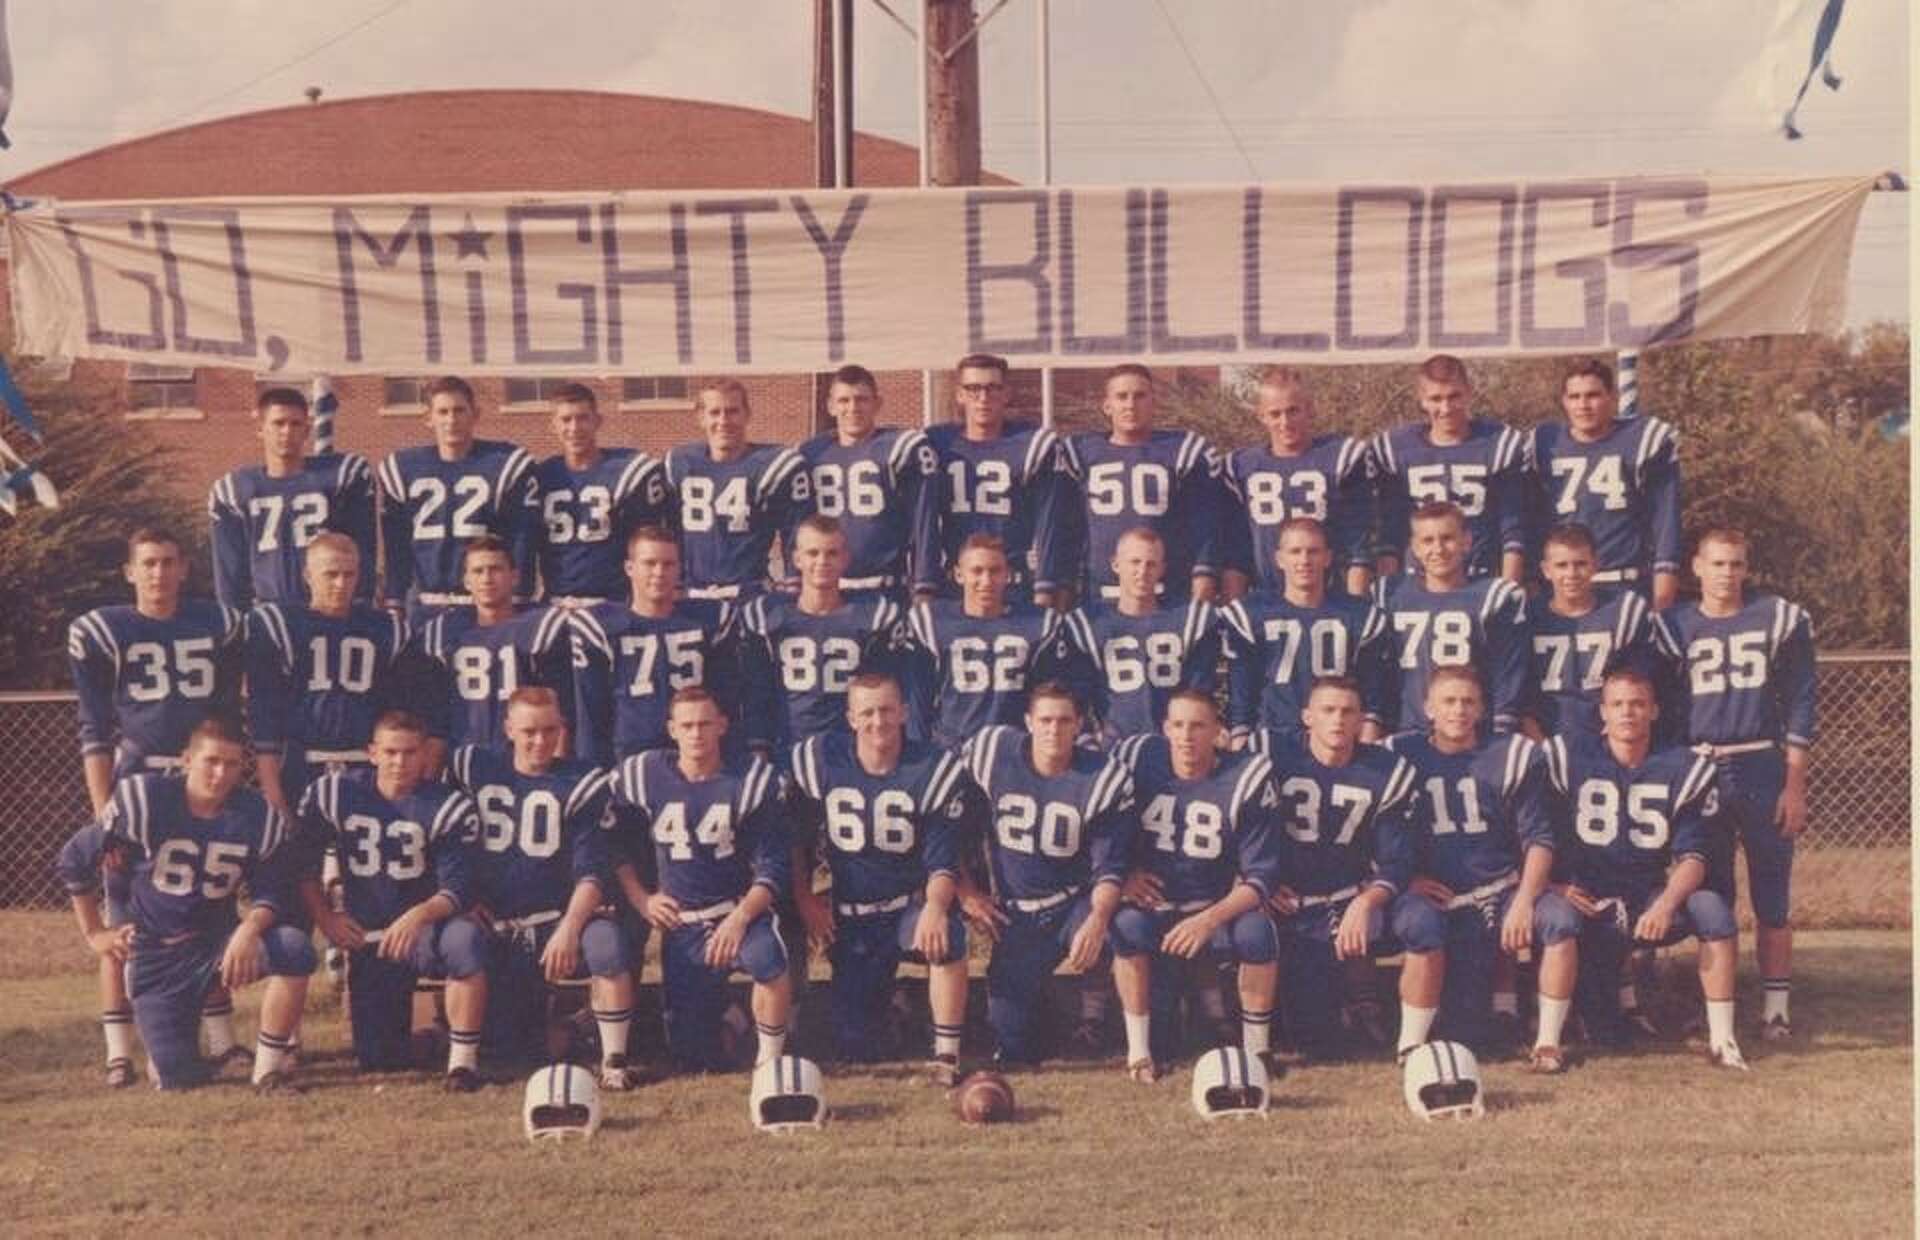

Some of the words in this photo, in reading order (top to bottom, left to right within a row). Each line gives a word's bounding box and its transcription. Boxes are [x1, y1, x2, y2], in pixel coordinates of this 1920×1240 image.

[58, 206, 290, 371] GO,
[965, 179, 1708, 355] BULLDOGS
[409, 475, 490, 541] 22
[680, 476, 751, 533] 84
[812, 459, 885, 518] 86
[947, 459, 1012, 516] 12
[1087, 461, 1170, 517] 50
[1247, 470, 1327, 526] 83
[1407, 463, 1487, 517] 55
[1551, 454, 1627, 514] 74
[249, 491, 330, 553] 72
[125, 636, 215, 702] 35
[307, 636, 376, 693] 10
[620, 628, 704, 697] 75
[779, 636, 861, 692] 82
[949, 634, 1029, 693] 62
[1103, 632, 1183, 693] 68
[1263, 618, 1348, 684] 70
[1392, 610, 1472, 669] 78
[1533, 630, 1613, 691] 77
[1687, 630, 1767, 695] 25
[453, 644, 518, 701] 81
[477, 783, 561, 858] 60
[652, 801, 736, 860] 44
[825, 786, 915, 852] 66
[996, 793, 1081, 857] 20
[1141, 794, 1223, 859] 48
[1281, 776, 1372, 844] 37
[1425, 776, 1488, 835] 11
[1575, 778, 1669, 849] 85
[151, 839, 249, 898] 65
[344, 813, 426, 880] 33
